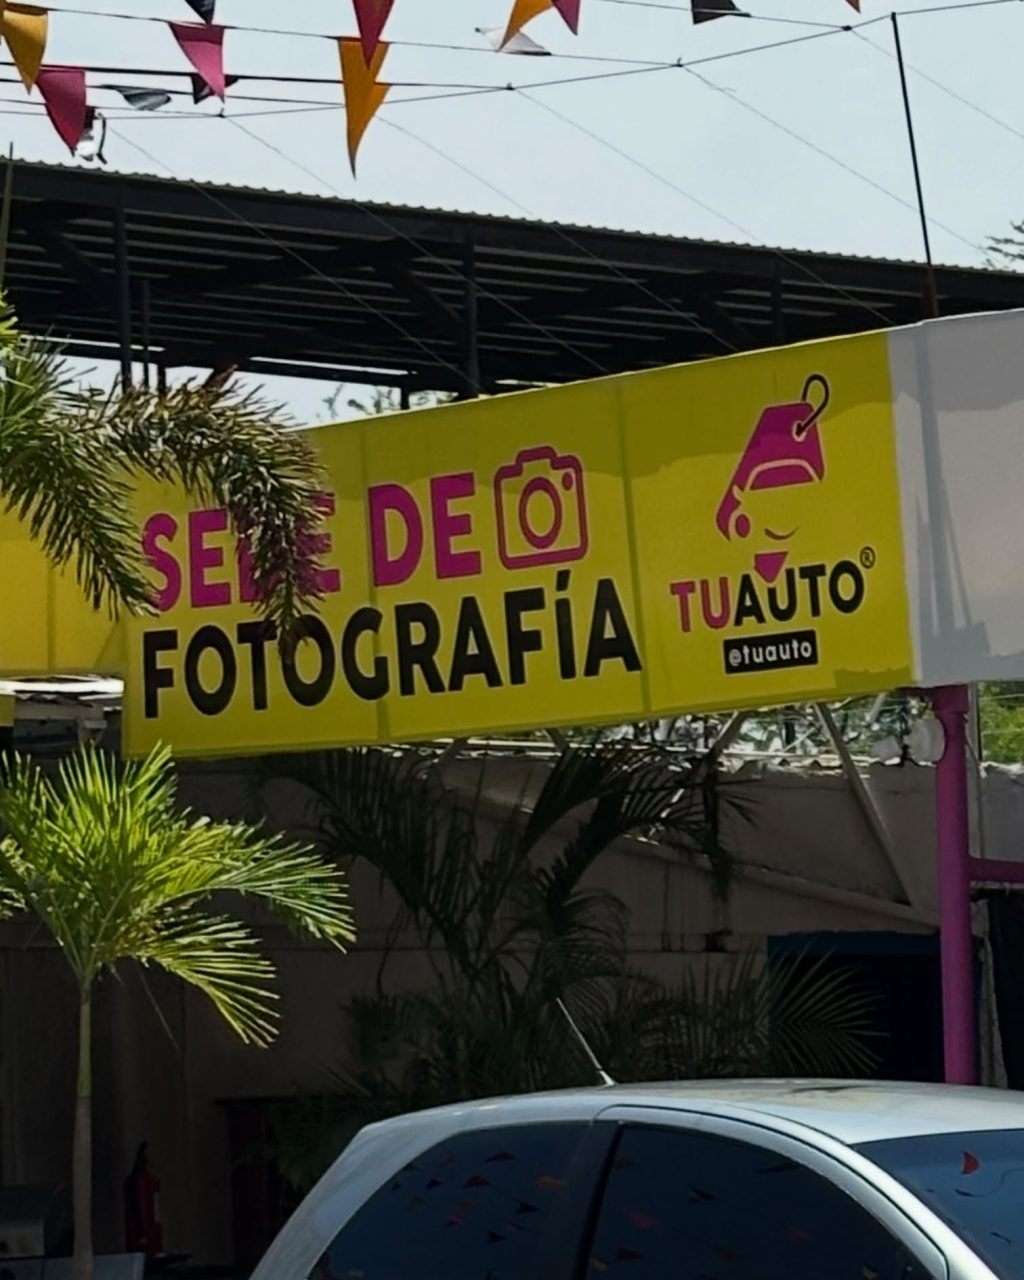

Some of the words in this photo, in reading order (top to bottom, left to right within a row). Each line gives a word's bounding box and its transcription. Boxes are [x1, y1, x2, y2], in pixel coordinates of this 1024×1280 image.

[369, 472, 482, 587] DE
[144, 569, 642, 717] FOTOGRAFÍA
[728, 638, 813, 667] @tuauto
